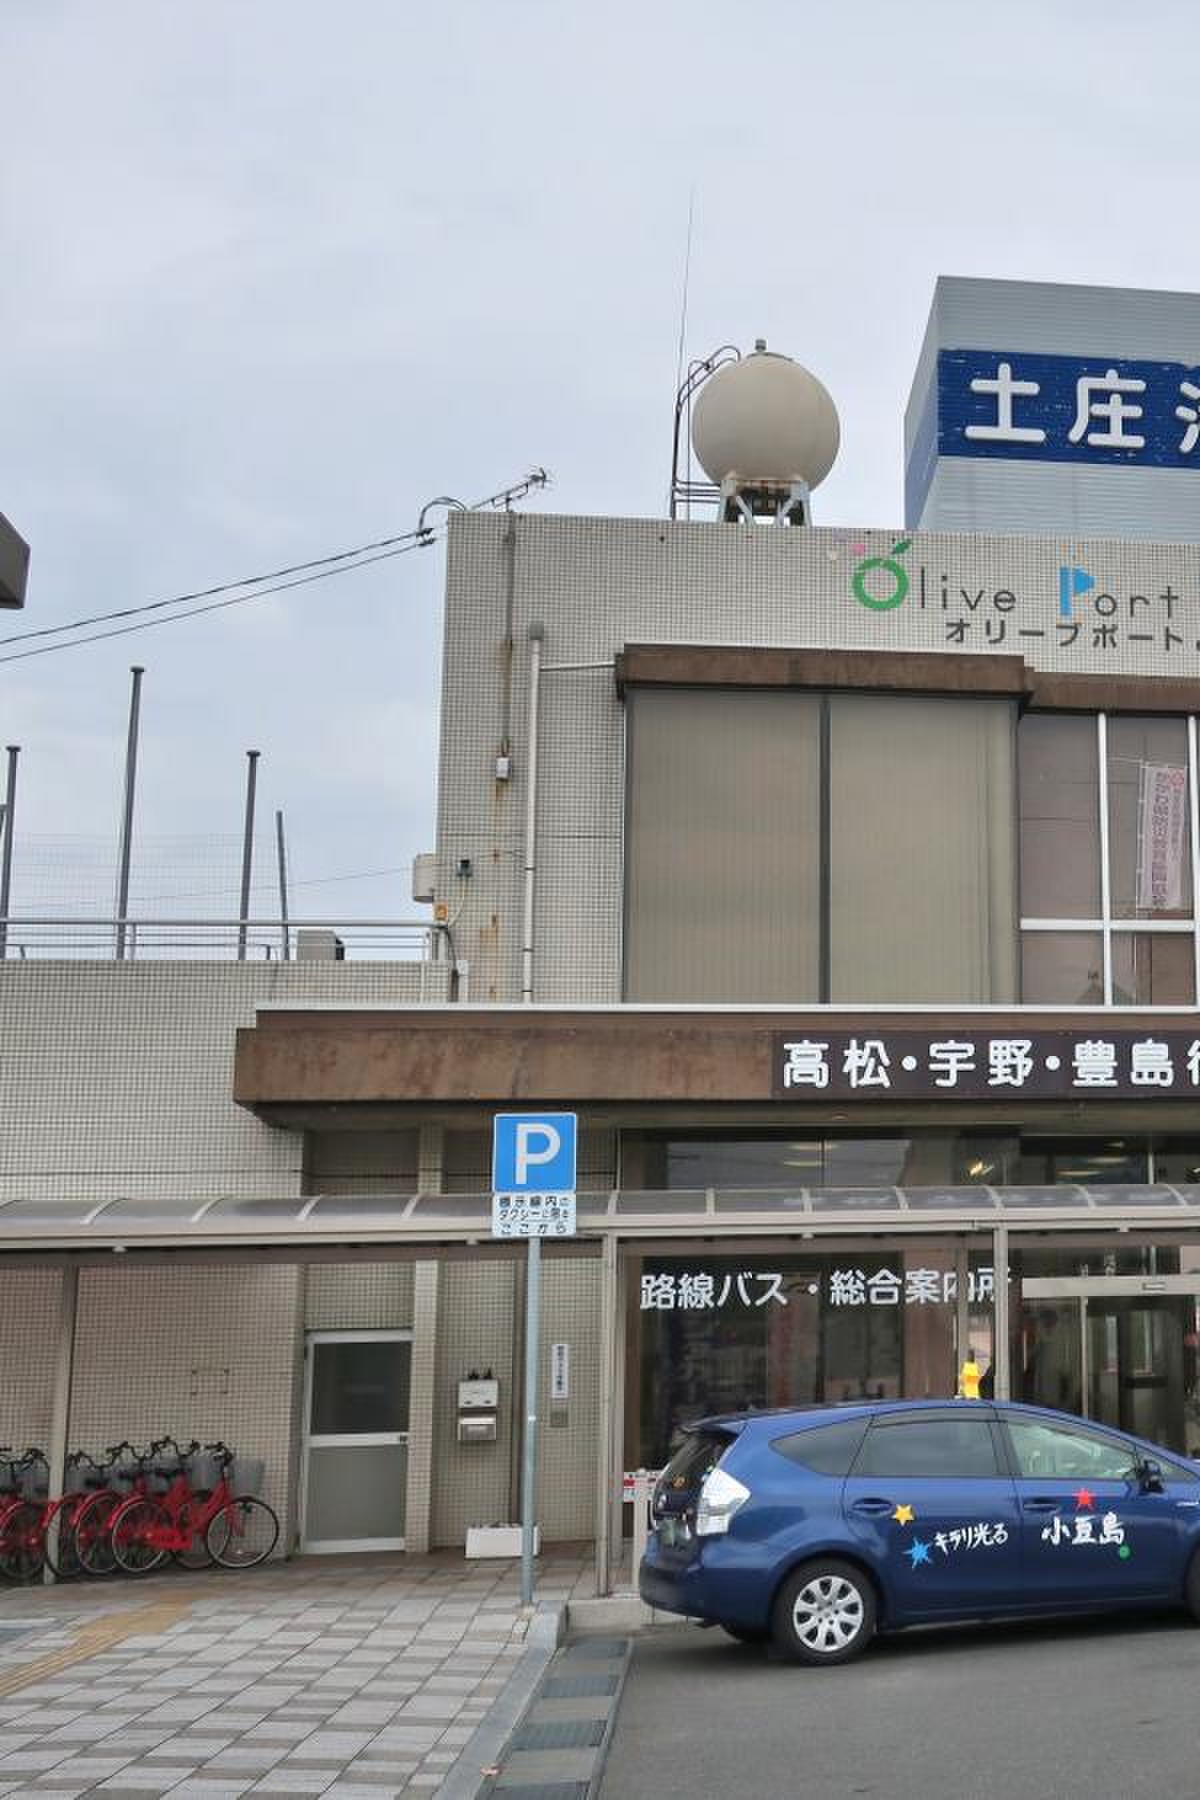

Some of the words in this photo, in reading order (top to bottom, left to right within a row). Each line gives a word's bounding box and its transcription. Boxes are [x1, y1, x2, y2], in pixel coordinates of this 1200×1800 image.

[851, 540, 1017, 611] Olive
[1059, 566, 1180, 619] Port
[515, 1123, 560, 1184] P
[933, 1522, 1009, 1555] キラリ光る
[1040, 1511, 1126, 1545] 小豆島
